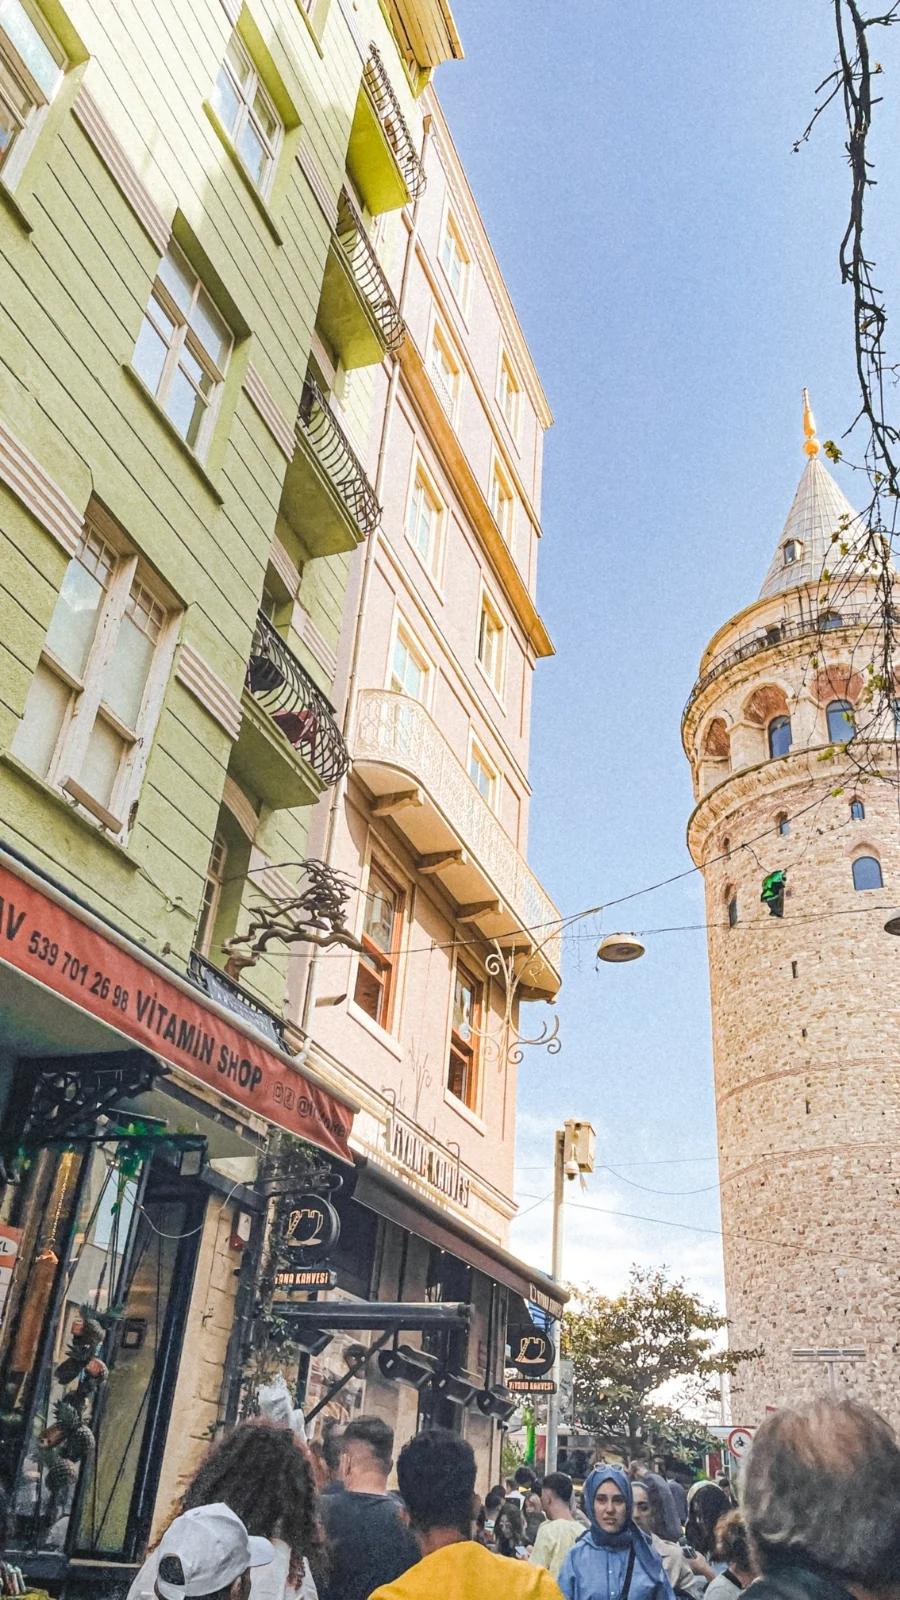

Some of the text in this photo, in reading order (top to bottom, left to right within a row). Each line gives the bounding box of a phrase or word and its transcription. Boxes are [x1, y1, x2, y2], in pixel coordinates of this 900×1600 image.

[28, 930, 59, 966] 539
[61, 951, 88, 986] 701
[89, 972, 111, 1000] 26
[112, 985, 129, 1012] 98
[136, 989, 215, 1065] VİTAMİN
[217, 1044, 263, 1092] SHOP
[296, 1272, 329, 1284] KAHVESİ
